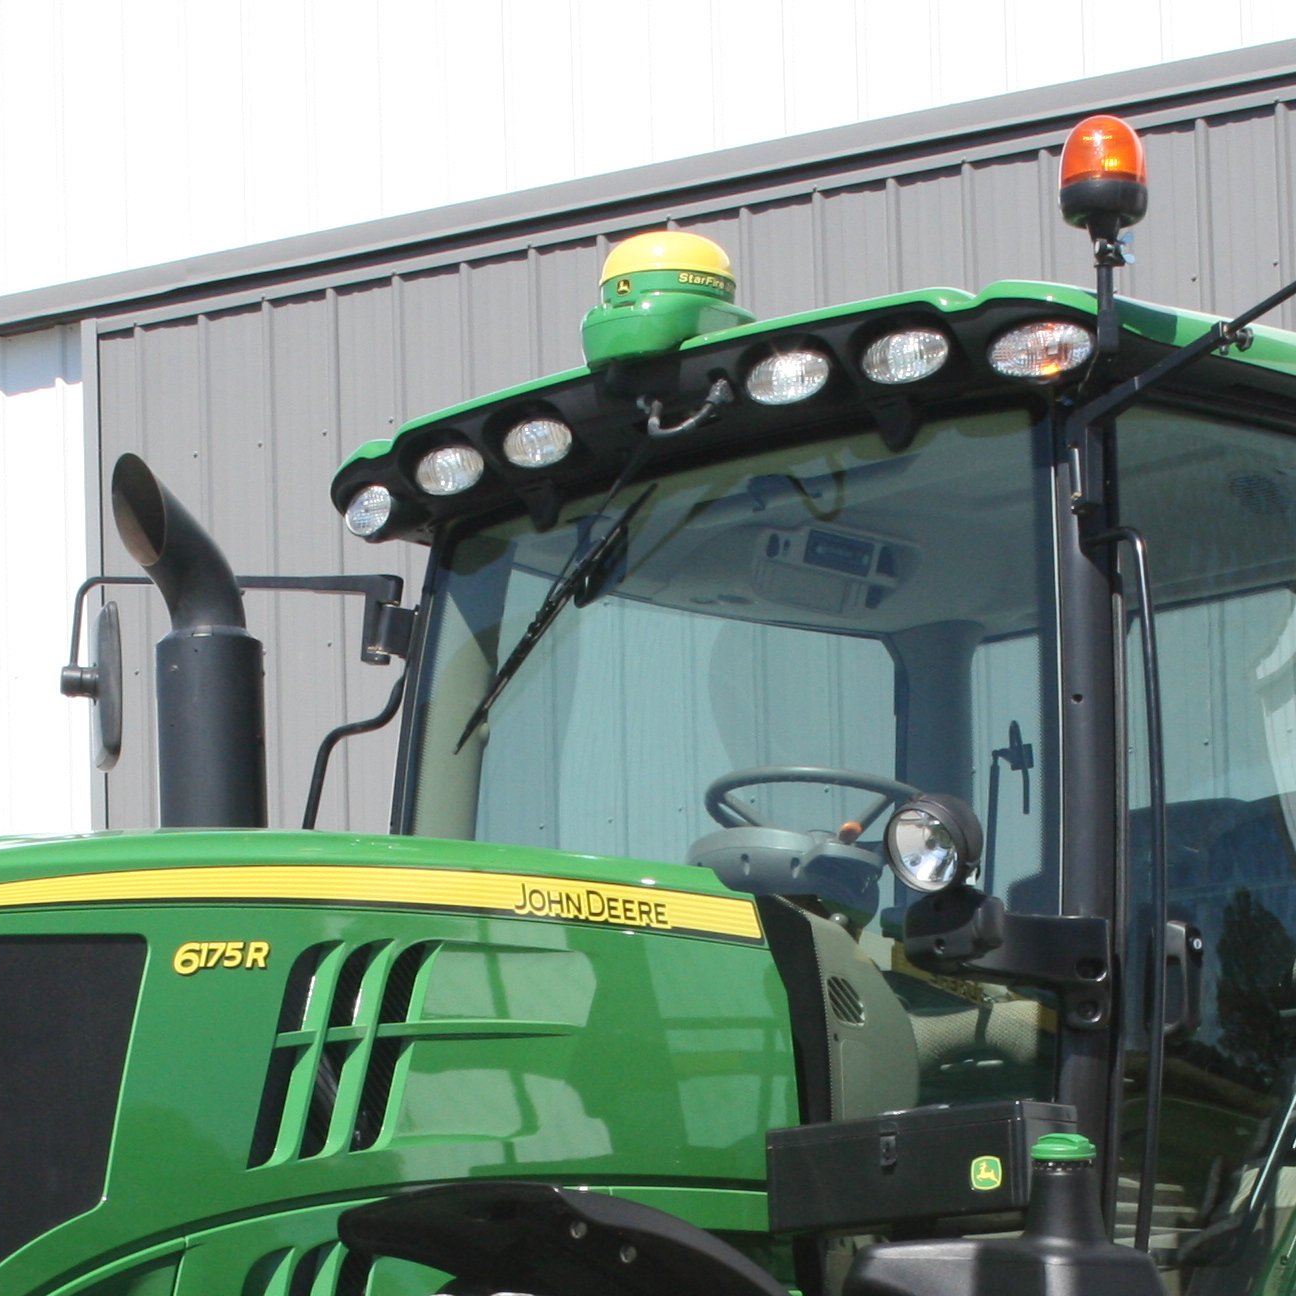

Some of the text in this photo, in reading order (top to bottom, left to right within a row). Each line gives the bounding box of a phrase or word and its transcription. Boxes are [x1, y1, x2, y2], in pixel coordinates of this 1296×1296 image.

[678, 271, 725, 290] StarFire
[515, 882, 670, 927] JOHN DEERE
